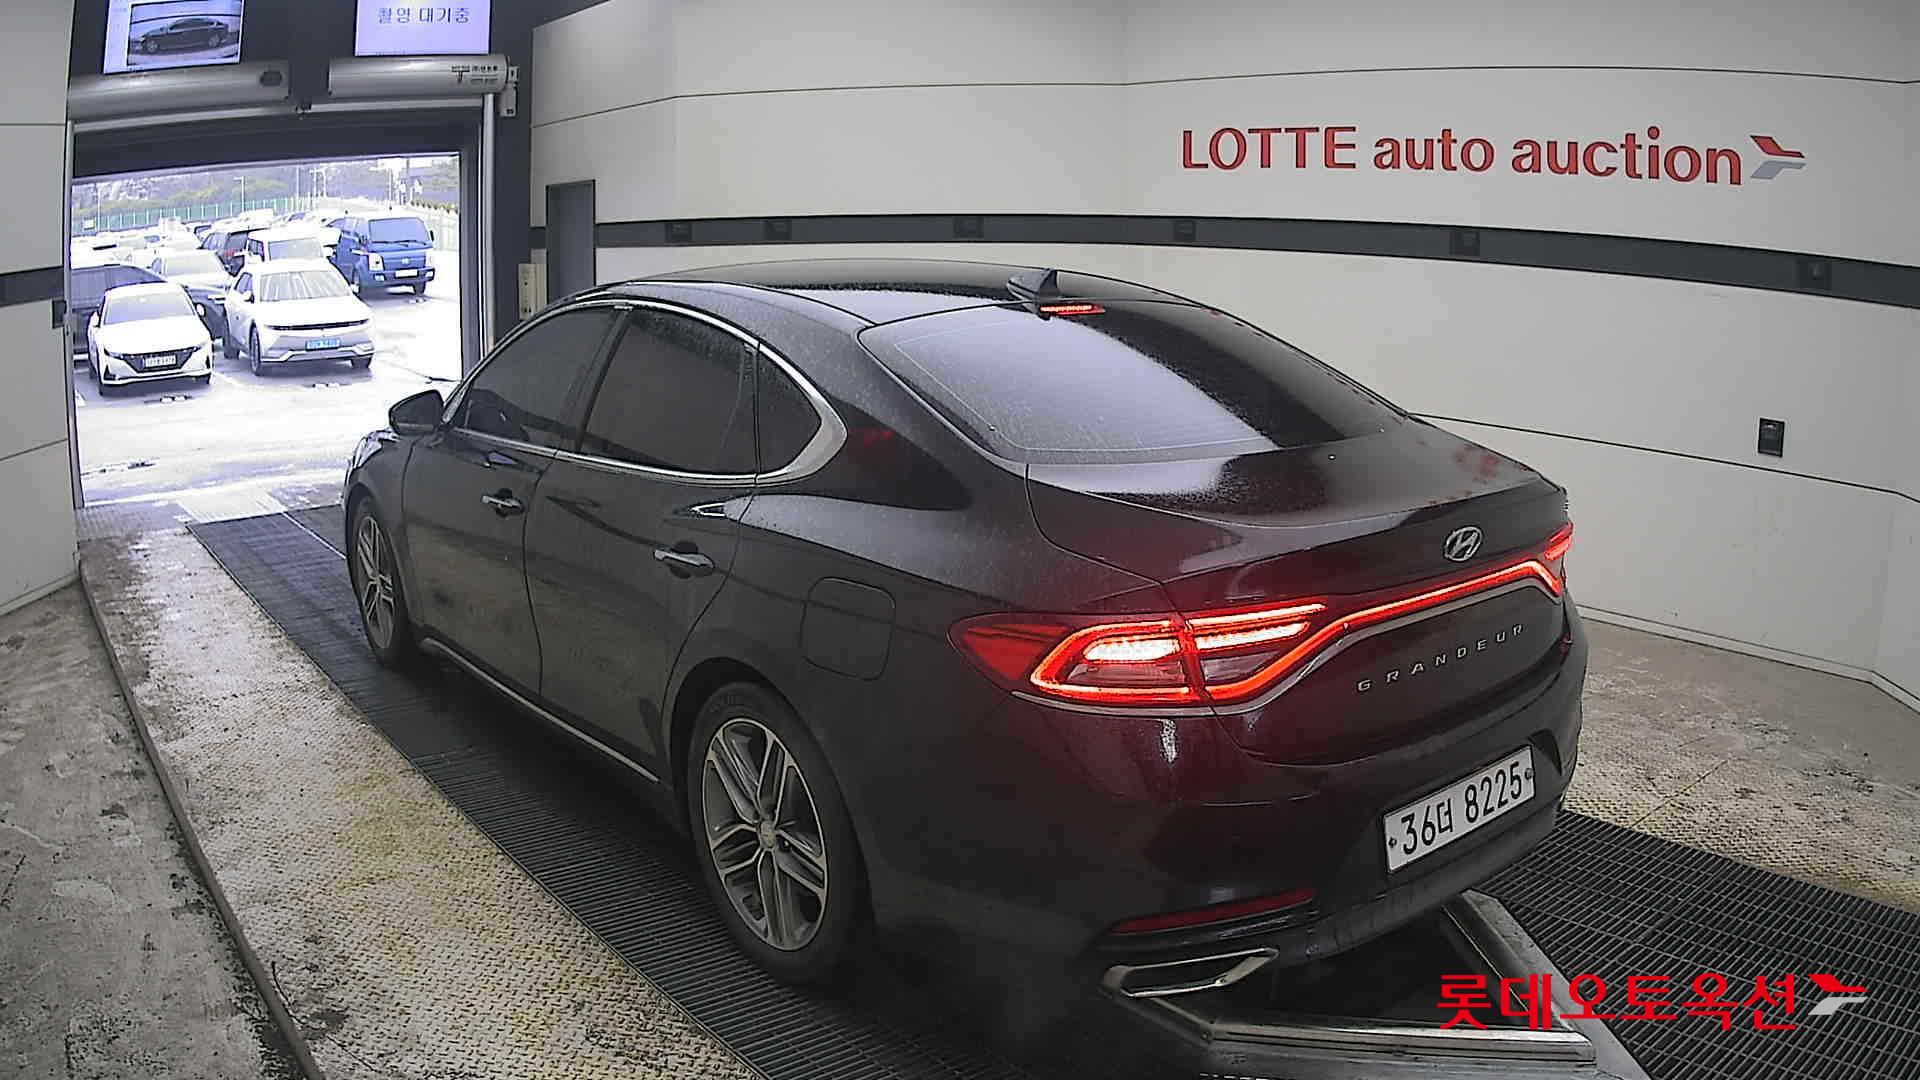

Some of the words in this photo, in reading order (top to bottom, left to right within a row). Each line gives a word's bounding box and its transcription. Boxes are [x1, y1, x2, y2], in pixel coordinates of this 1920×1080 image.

[419, 7, 471, 24] 대기중
[1181, 126, 1357, 170] LOTTE
[1372, 128, 1495, 172] auto
[1511, 126, 1742, 185] auction
[1357, 624, 1522, 692] GRANDEUR
[1401, 797, 1453, 855] 36더
[1465, 761, 1523, 823] 8225
